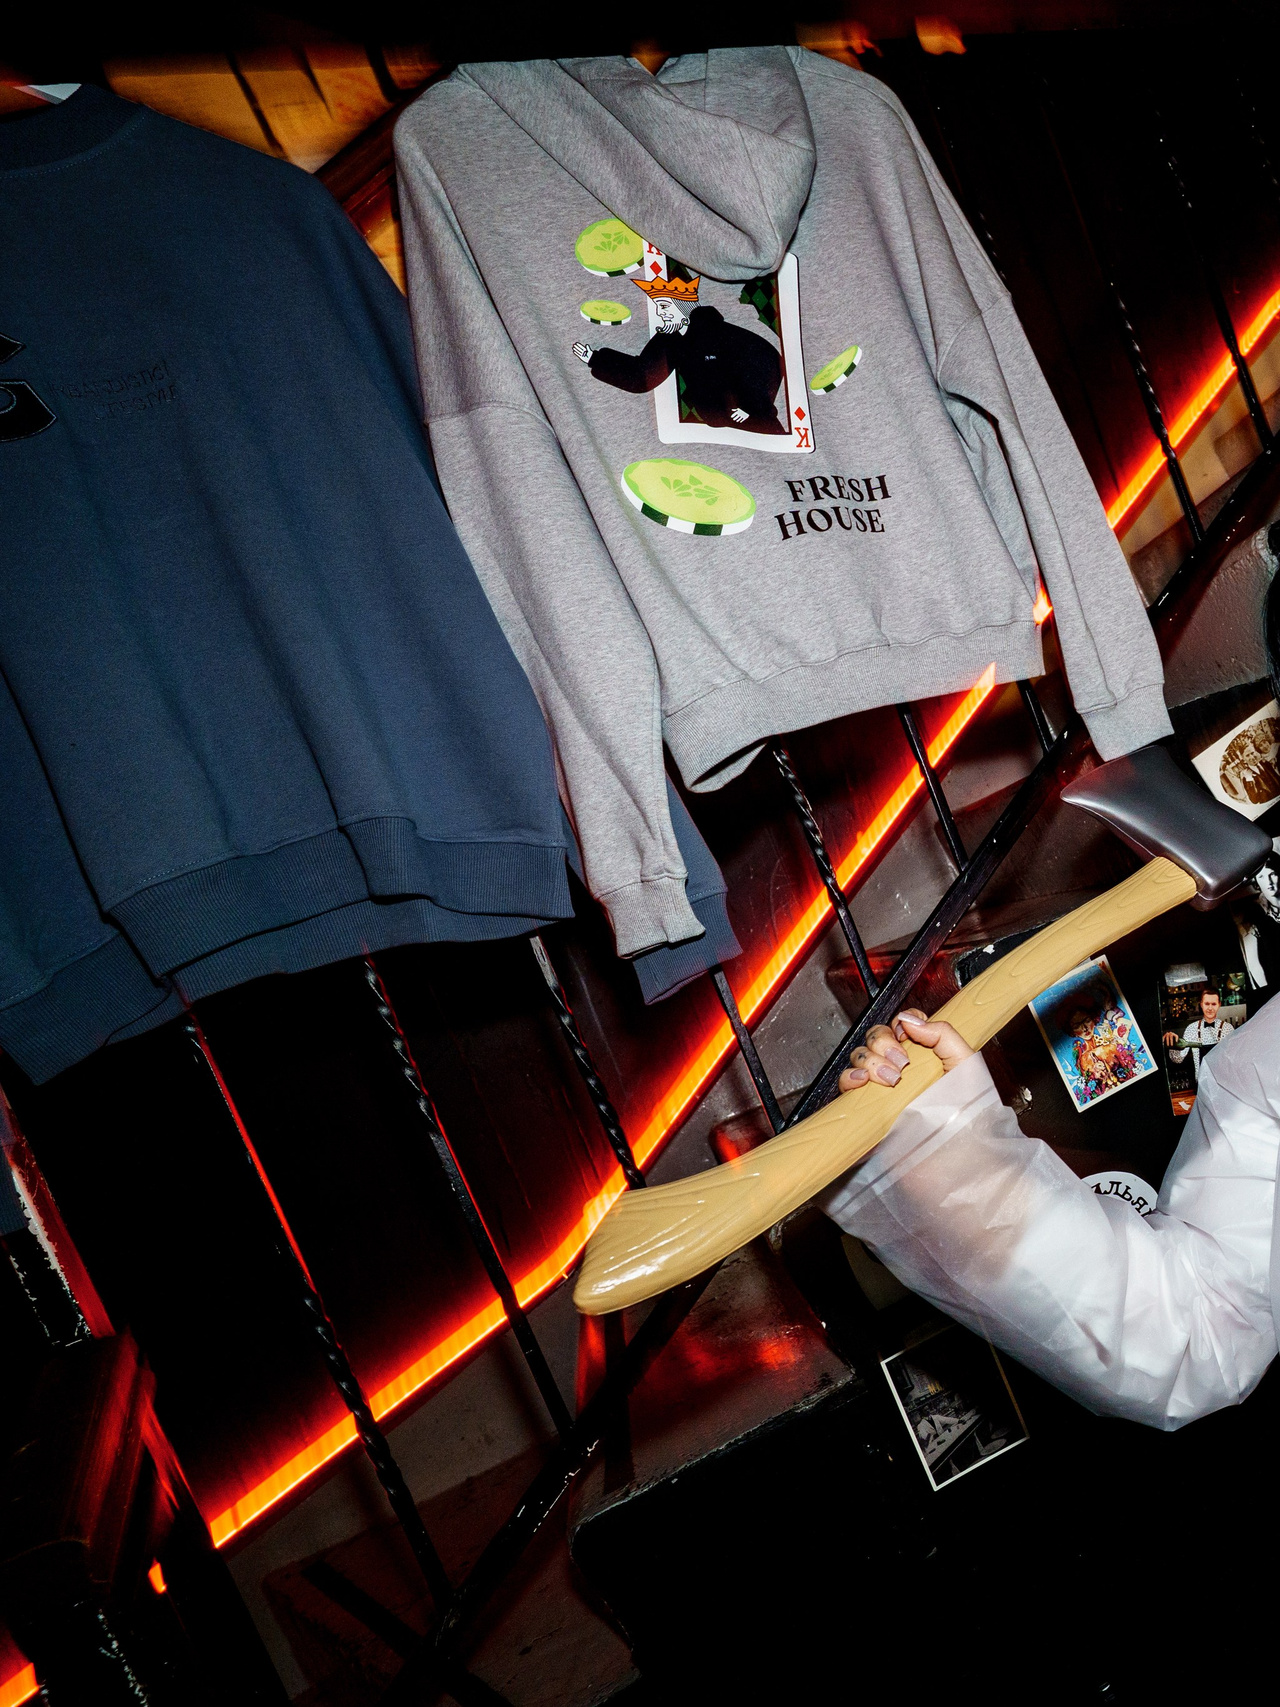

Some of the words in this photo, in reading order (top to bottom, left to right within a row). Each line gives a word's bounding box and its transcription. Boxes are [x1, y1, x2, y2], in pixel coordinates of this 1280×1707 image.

[794, 427, 811, 448] K
[784, 474, 892, 502] FRESH
[774, 506, 886, 541] HOUSE
